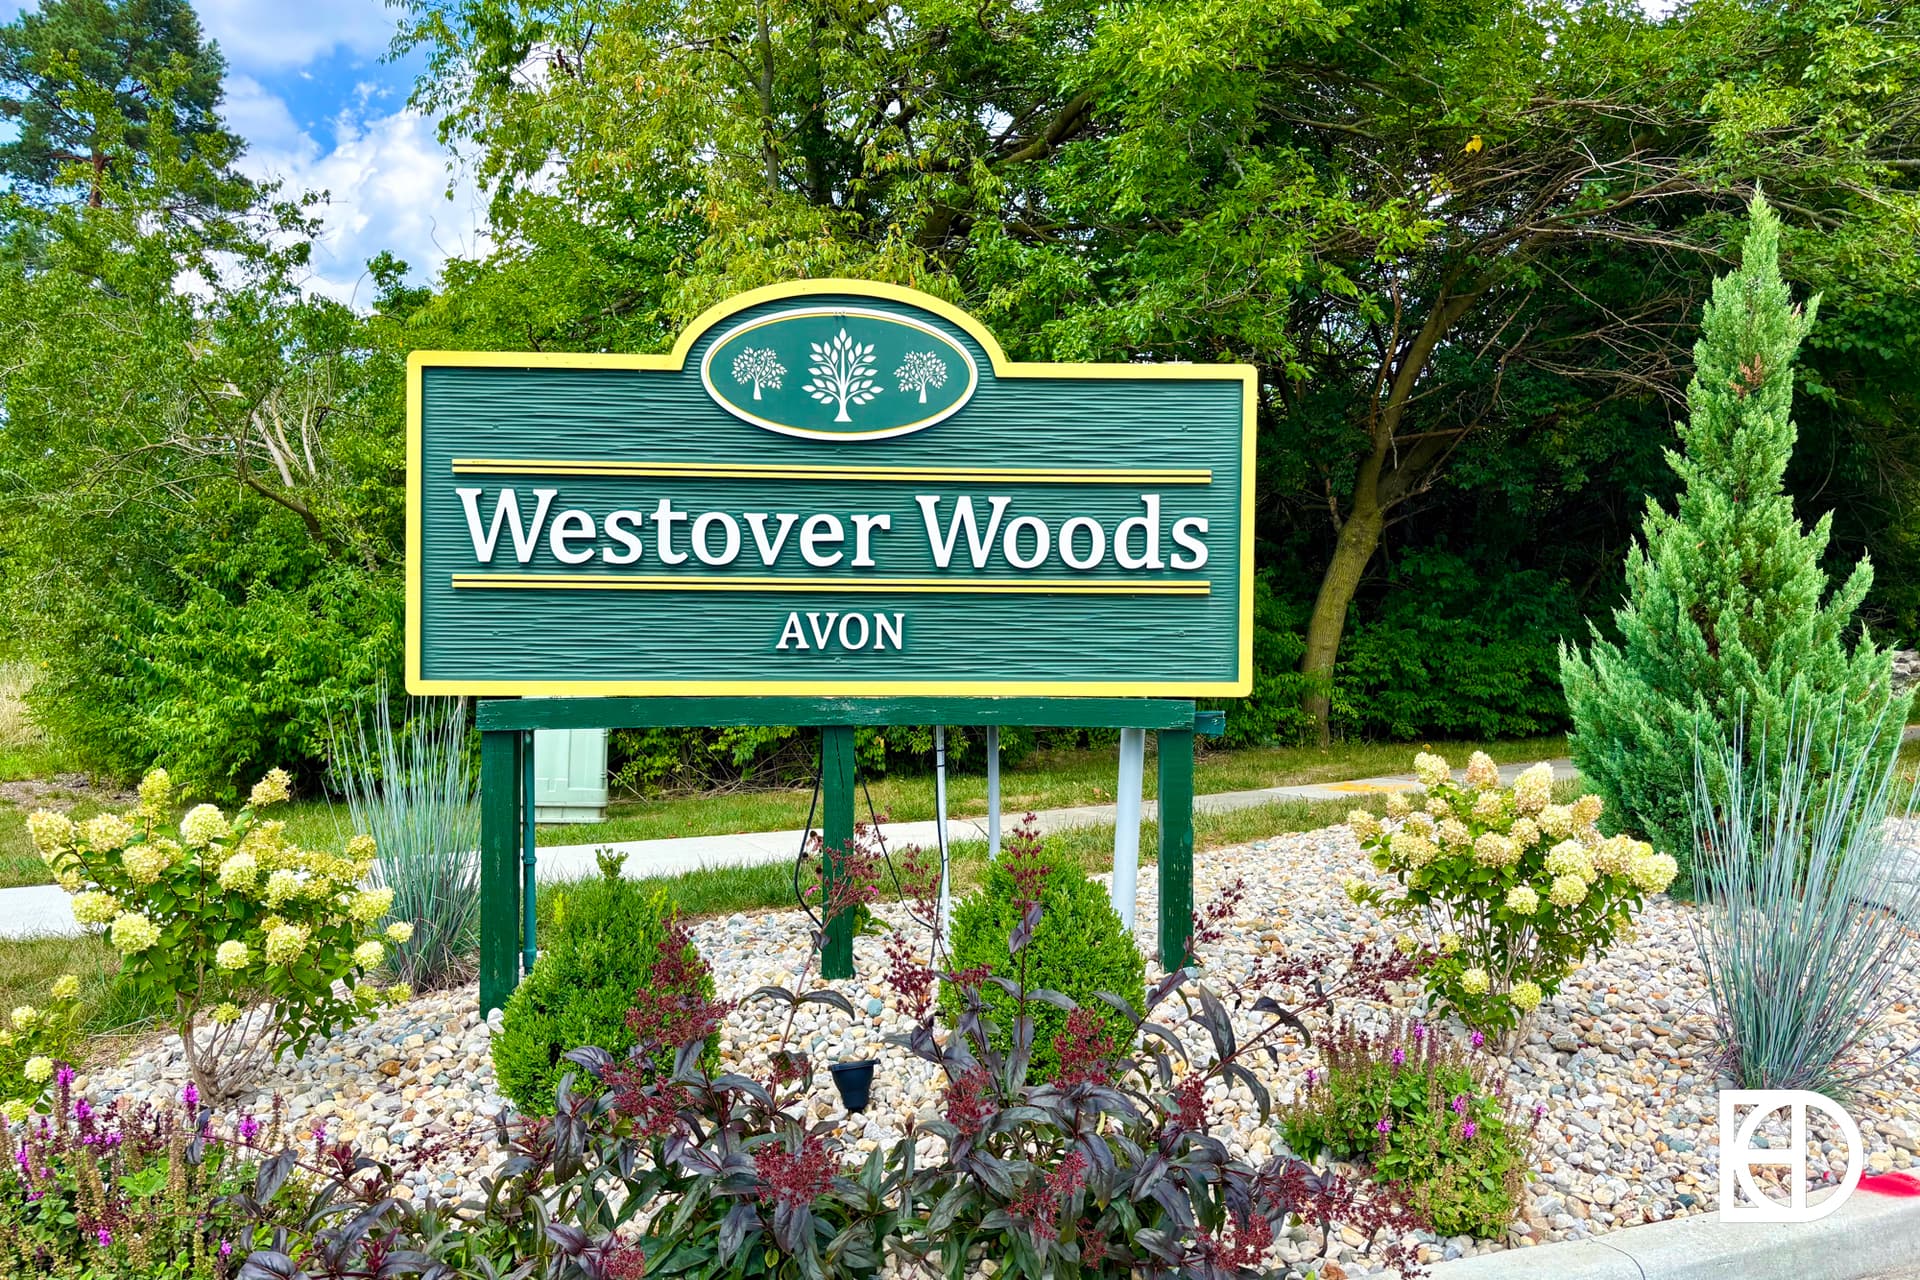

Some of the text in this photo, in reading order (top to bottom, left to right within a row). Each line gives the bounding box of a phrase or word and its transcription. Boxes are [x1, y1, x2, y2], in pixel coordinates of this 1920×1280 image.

[455, 487, 1210, 571] Westover Woods
[775, 610, 905, 651] AVON
